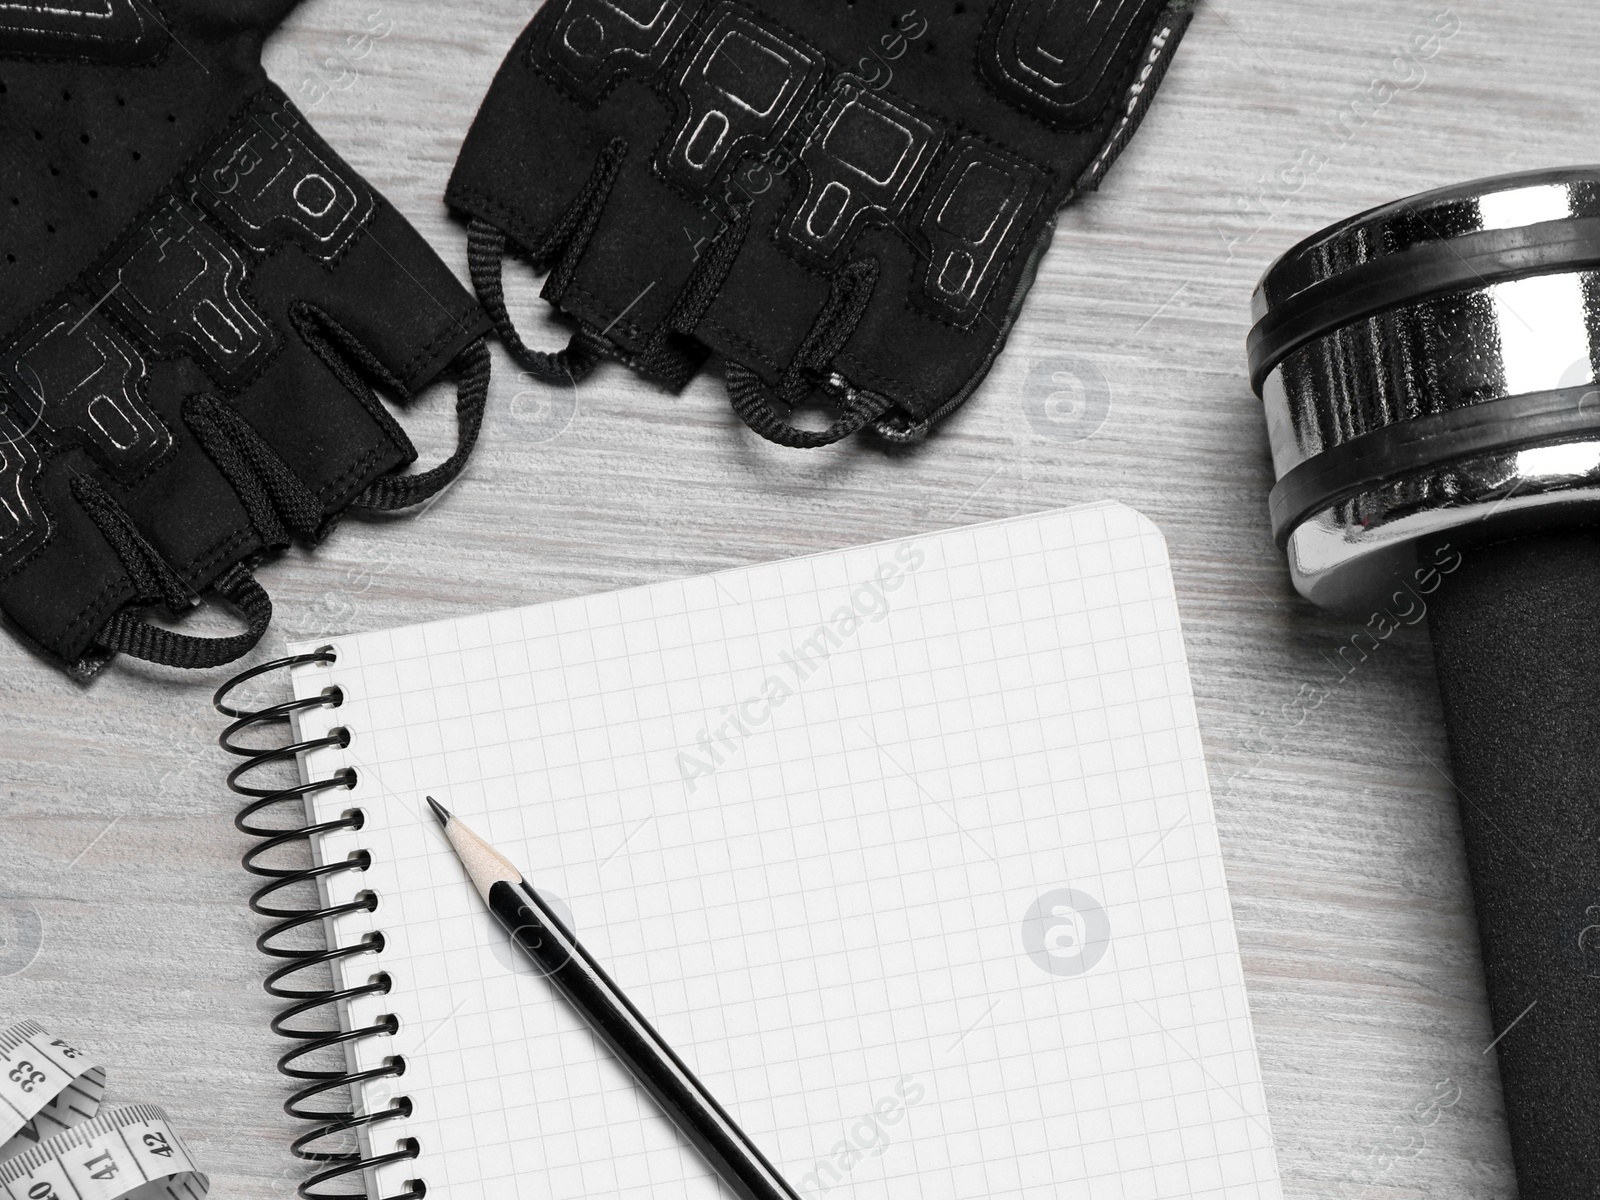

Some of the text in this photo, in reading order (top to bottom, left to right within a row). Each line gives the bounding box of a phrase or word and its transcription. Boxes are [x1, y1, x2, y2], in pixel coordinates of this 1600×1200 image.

[8, 1060, 46, 1093] 33
[142, 1131, 174, 1159] 42
[83, 1148, 120, 1182] 41
